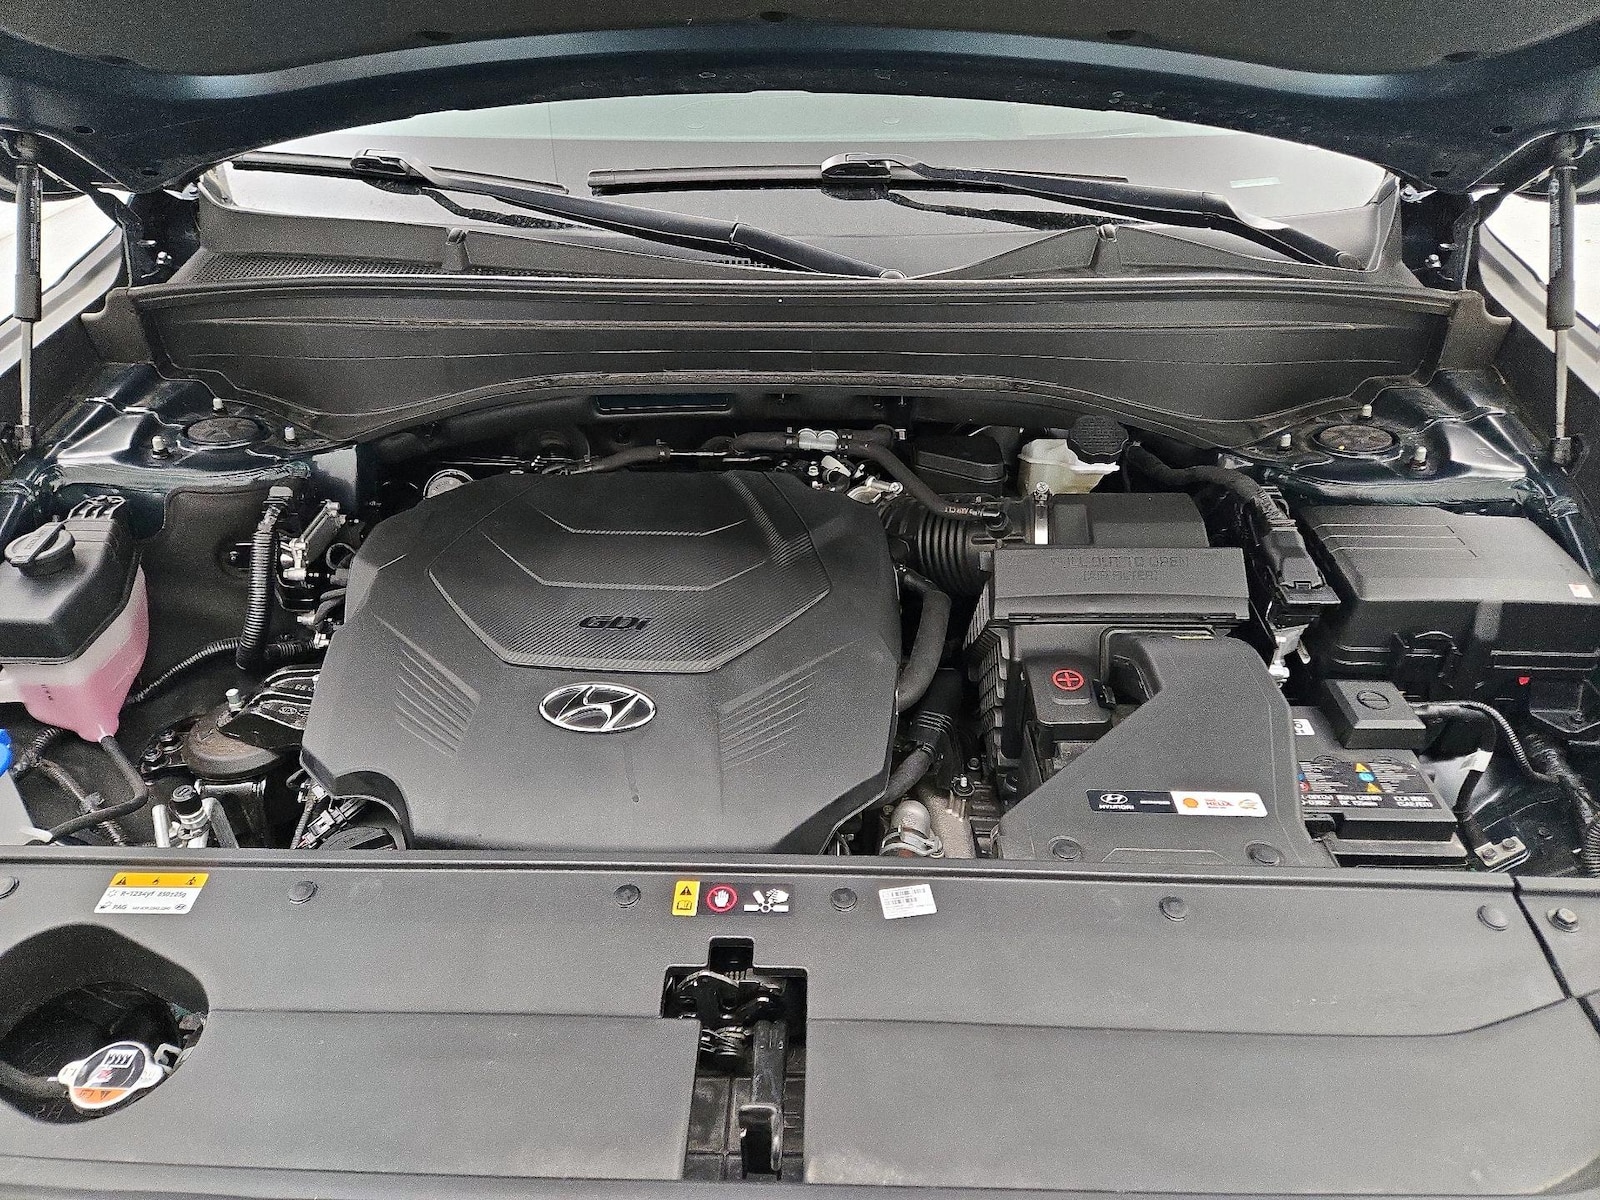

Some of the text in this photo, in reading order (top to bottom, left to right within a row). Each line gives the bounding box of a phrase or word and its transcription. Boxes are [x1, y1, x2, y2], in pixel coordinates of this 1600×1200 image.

[1091, 556, 1120, 568] OUT
[1124, 556, 1145, 568] TO
[1148, 556, 1190, 568] OPEN
[120, 890, 155, 898] R-1234yf
